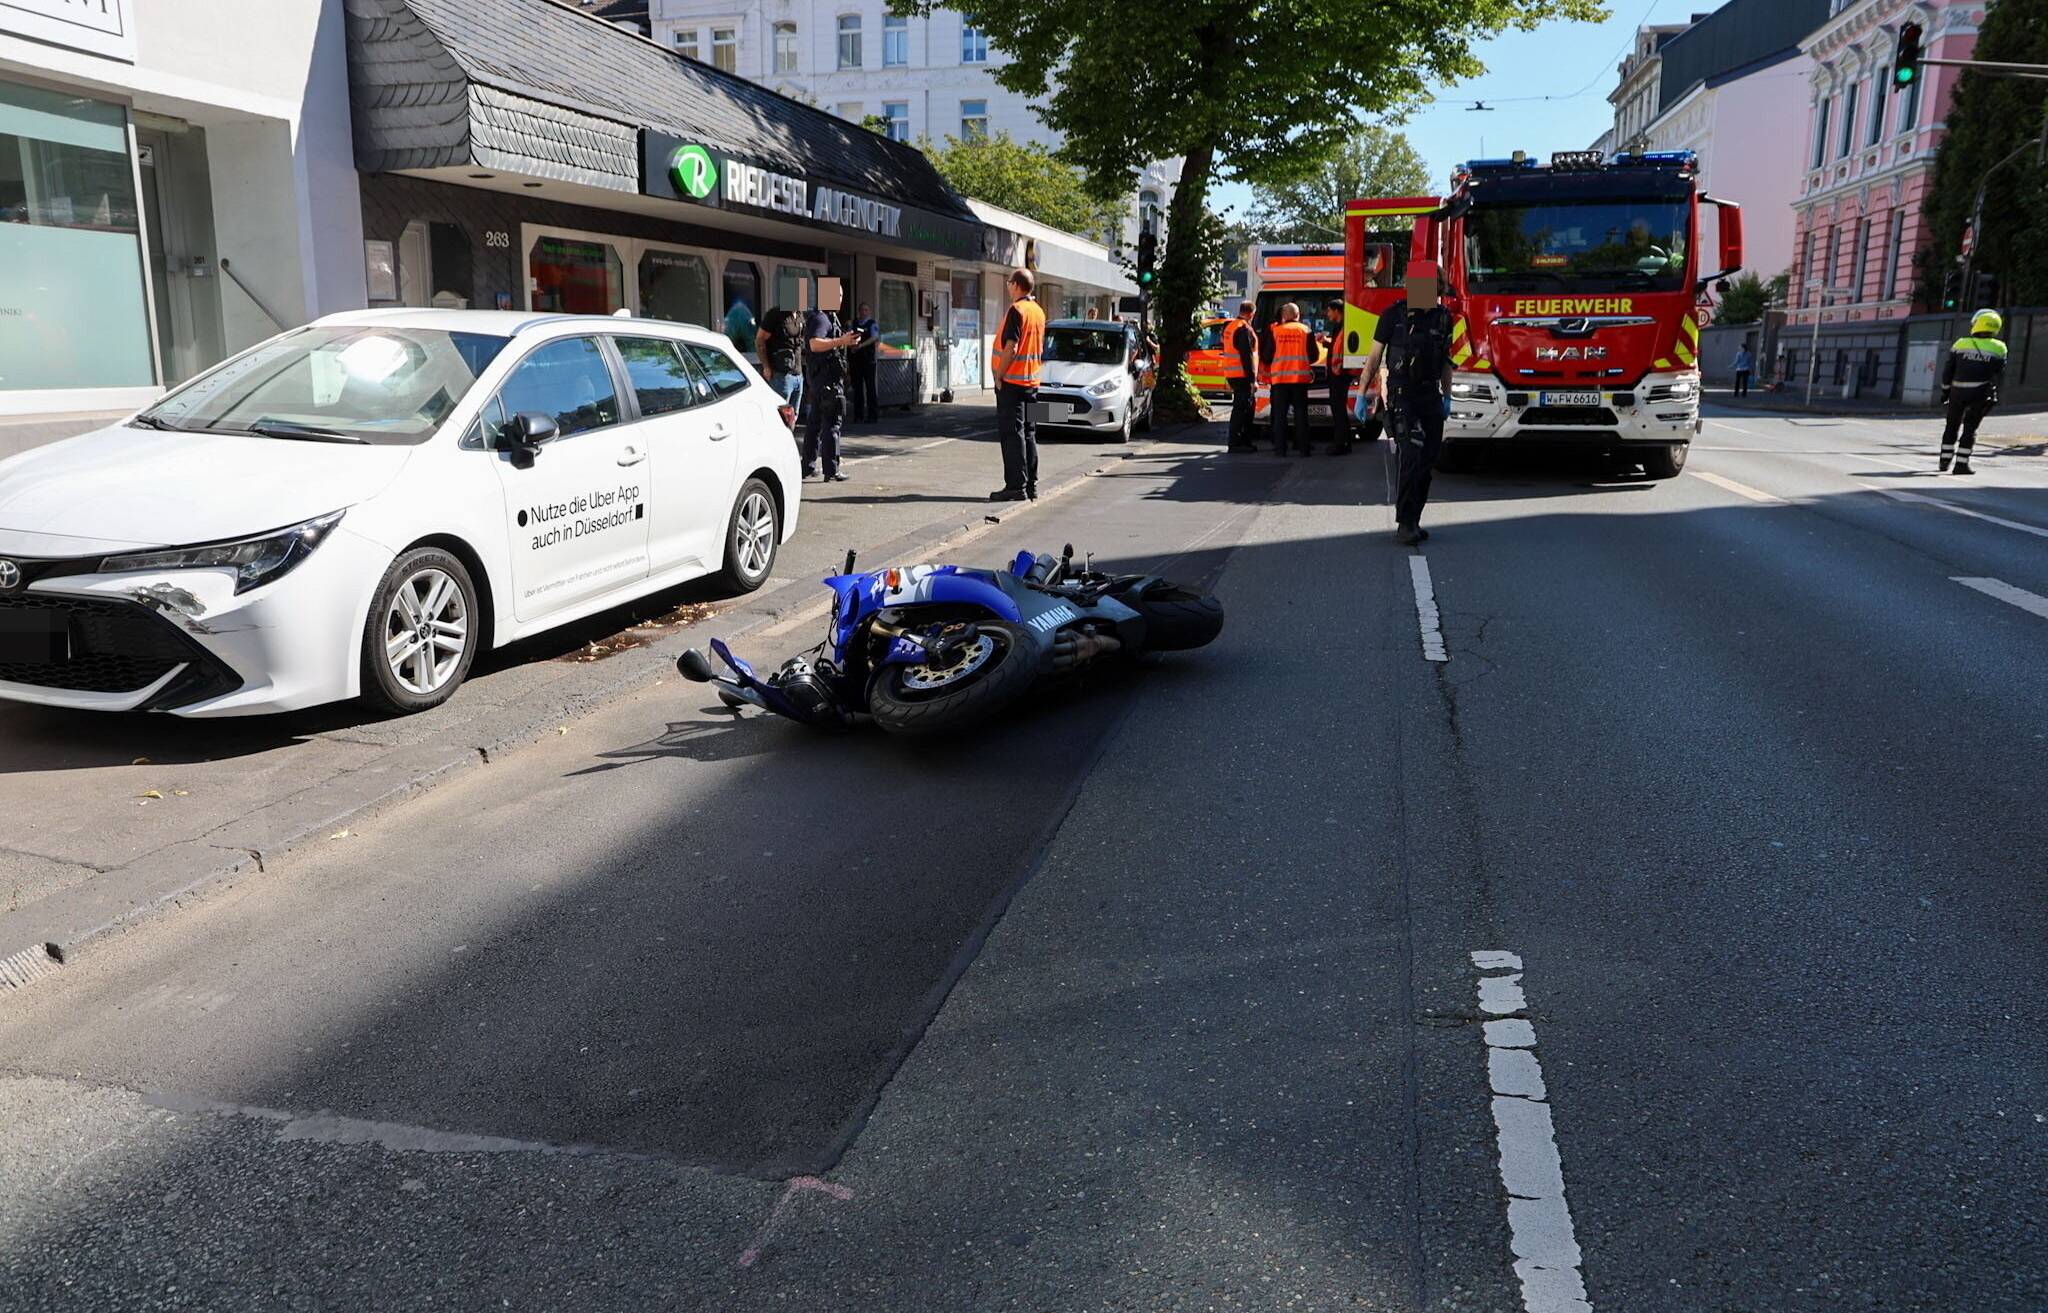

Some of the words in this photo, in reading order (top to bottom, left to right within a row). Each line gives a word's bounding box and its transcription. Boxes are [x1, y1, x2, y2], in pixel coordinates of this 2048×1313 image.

[722, 159, 812, 219] RIEDESEL
[814, 186, 901, 238] AUGENOPTIK
[486, 231, 510, 247] 263
[1515, 298, 1632, 314] FEUERWEHR
[1536, 347, 1606, 360] MAN
[1573, 394, 1597, 404] 6616
[531, 503, 567, 525] Nutze
[569, 496, 587, 515] die
[589, 490, 615, 509] Uber
[618, 485, 640, 504] App
[532, 527, 561, 550] auch
[563, 524, 573, 541] in
[575, 505, 634, 537] Düsseldorf.
[1027, 605, 1077, 633] YAMAHA
